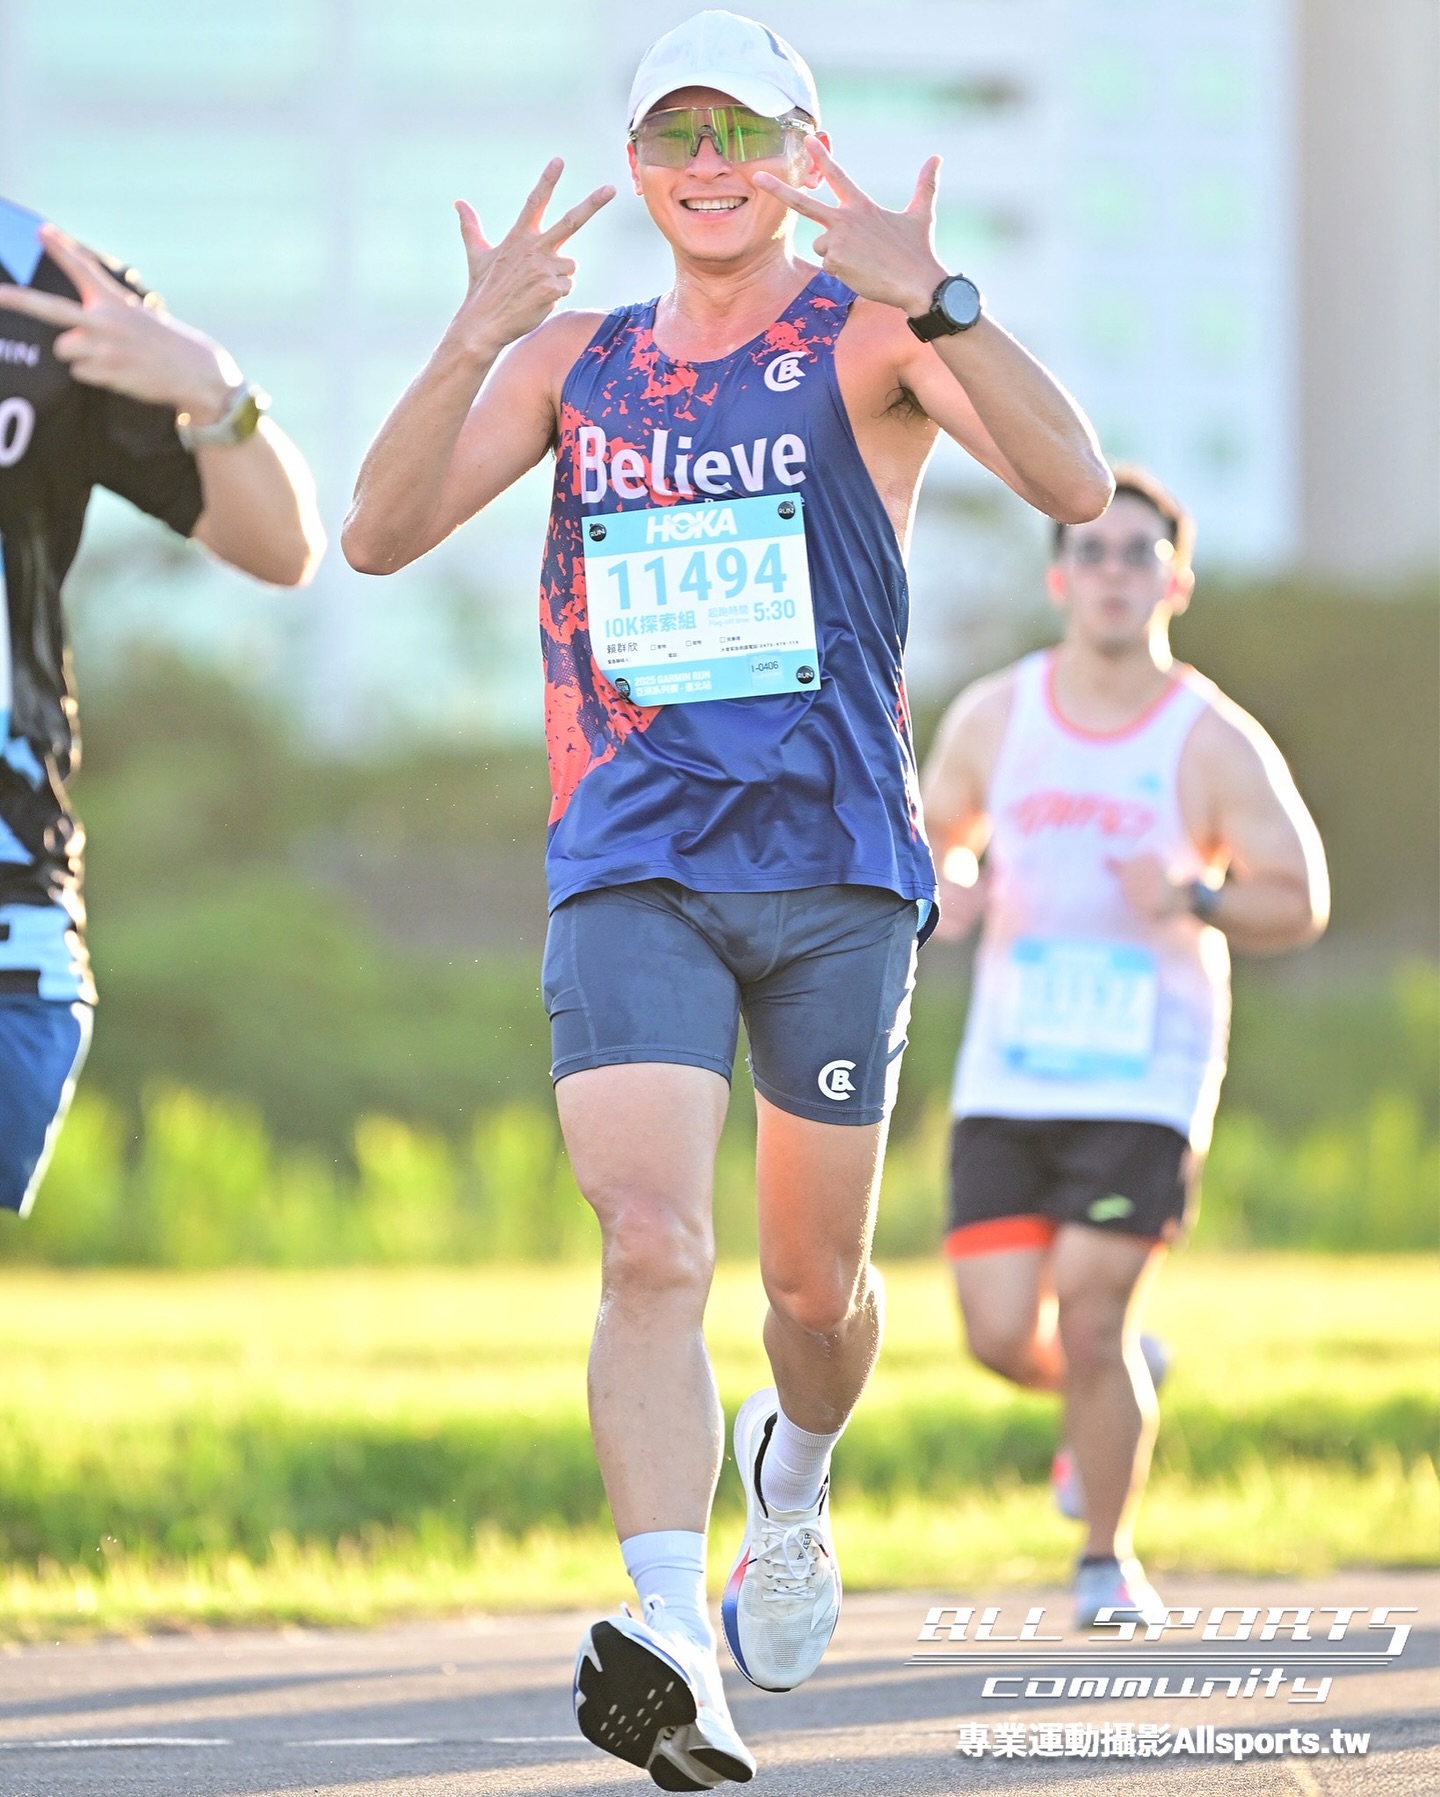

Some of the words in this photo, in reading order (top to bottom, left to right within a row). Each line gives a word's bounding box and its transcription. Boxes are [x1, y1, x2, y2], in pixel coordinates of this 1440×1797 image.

[579, 426, 807, 504] Believe
[645, 507, 738, 544] HOKA
[608, 543, 787, 610] 11494
[753, 599, 796, 622] 5:30
